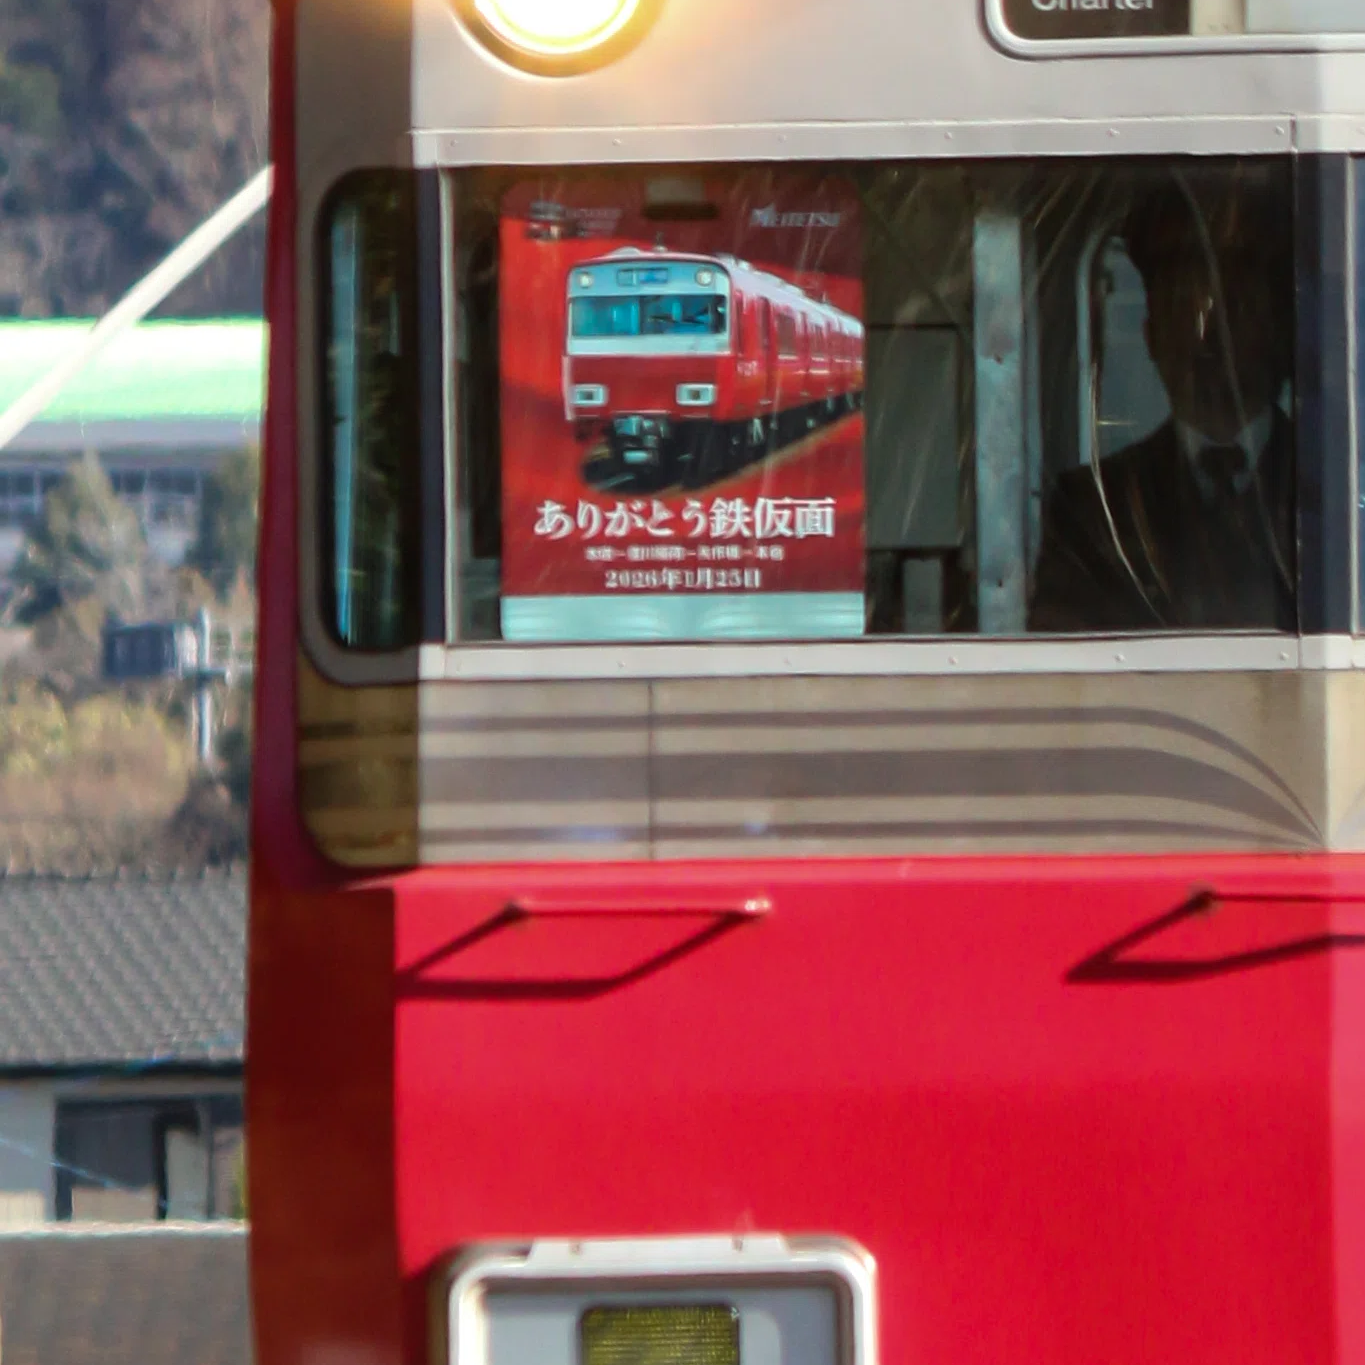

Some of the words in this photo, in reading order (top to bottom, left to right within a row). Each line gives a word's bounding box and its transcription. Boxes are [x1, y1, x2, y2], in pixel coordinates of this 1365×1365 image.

[533, 497, 836, 539] ありがとう鉄仮面
